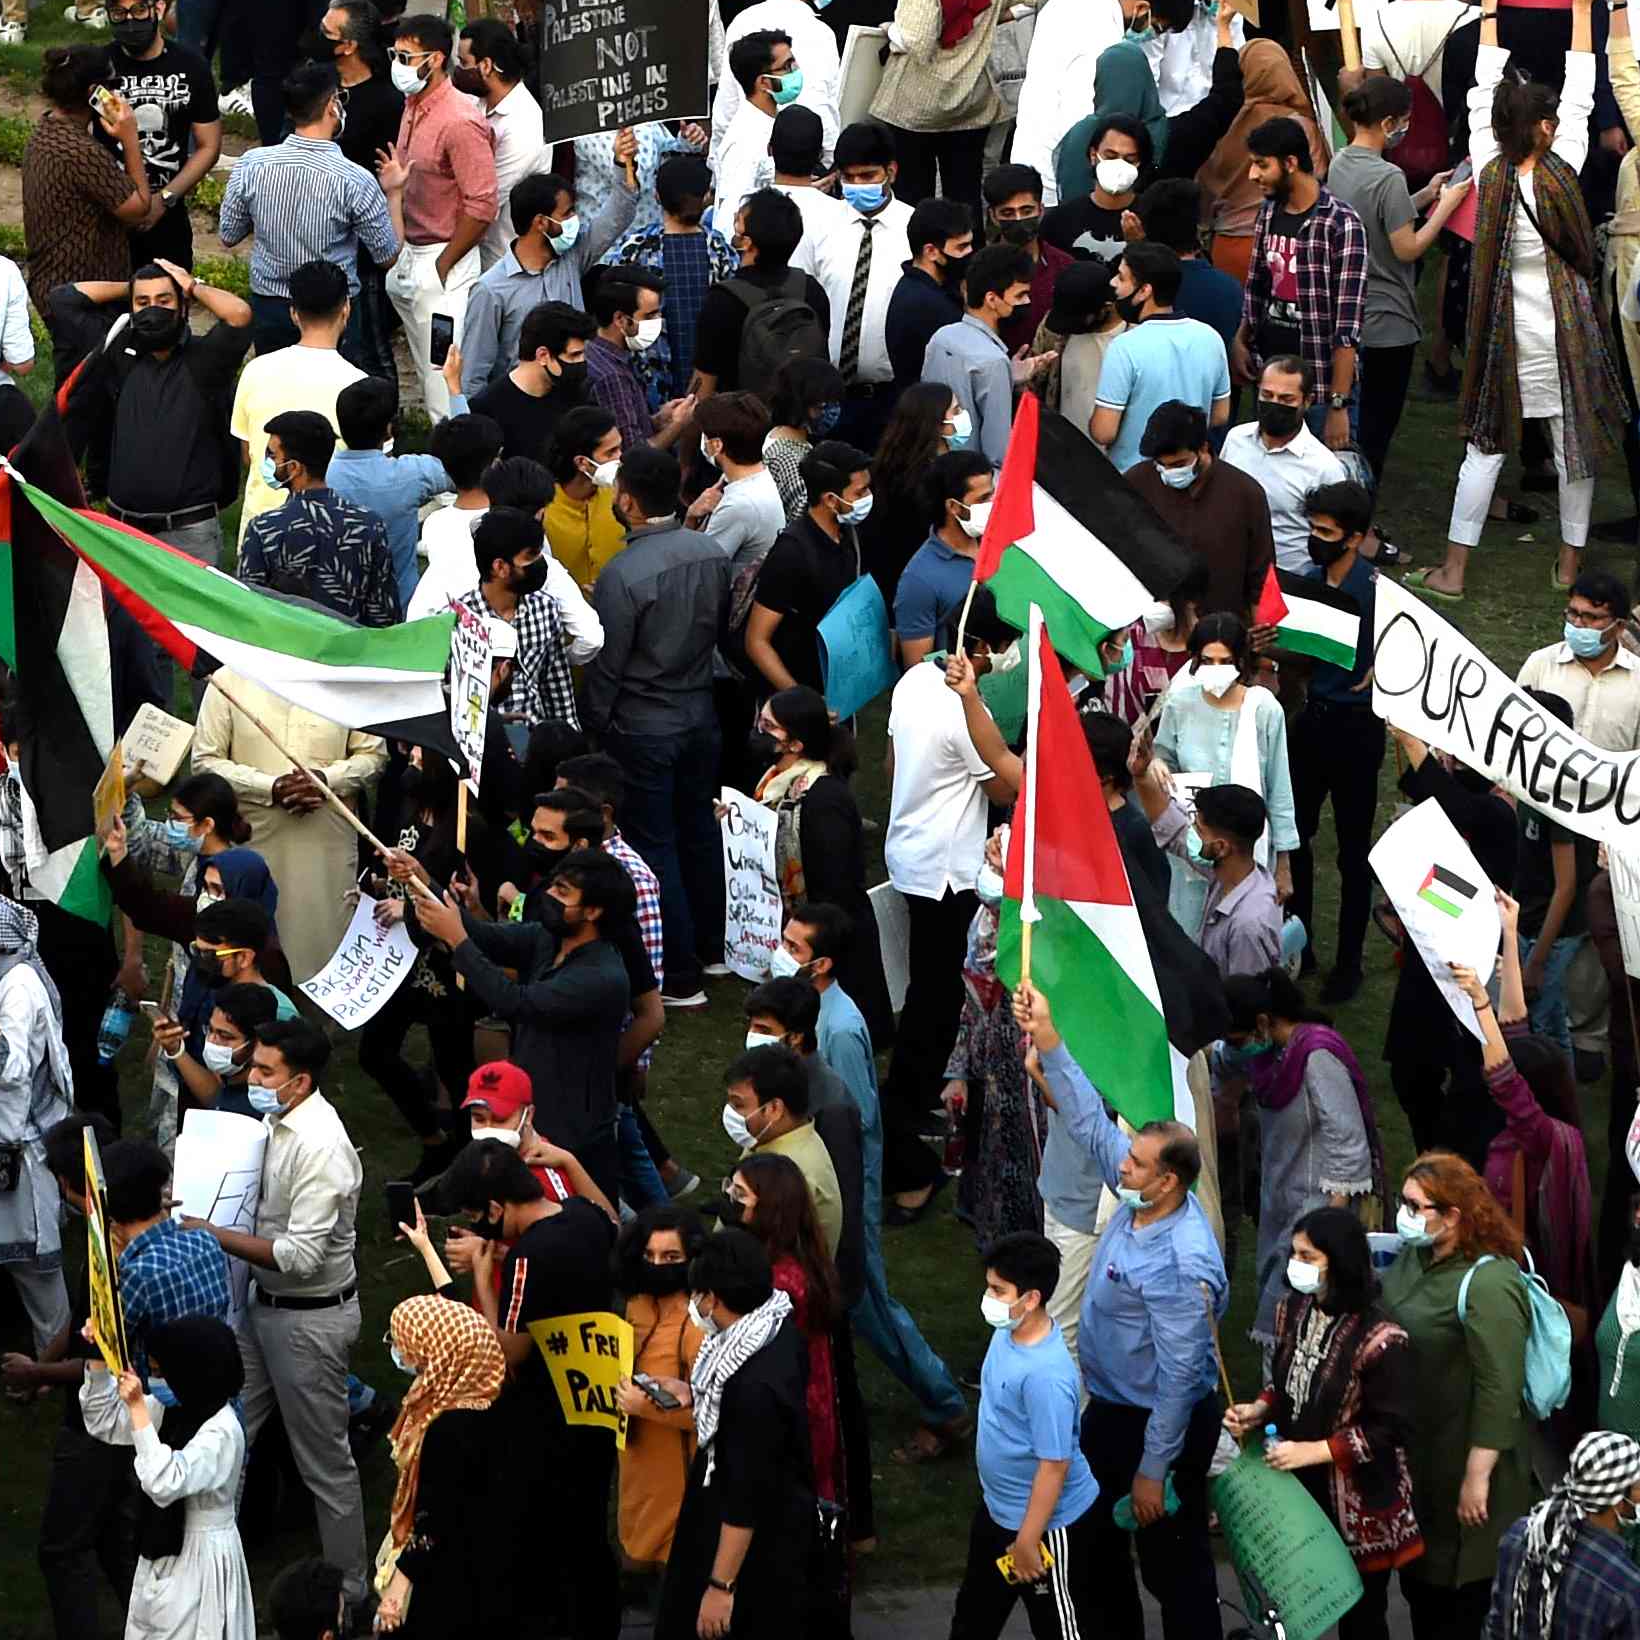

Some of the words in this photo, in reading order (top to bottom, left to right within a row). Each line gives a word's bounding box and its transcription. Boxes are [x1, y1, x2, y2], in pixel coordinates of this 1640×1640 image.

[543, 5, 626, 51] PALESTINE
[595, 23, 658, 70] NOT
[645, 63, 668, 88] IN
[597, 86, 669, 128] PIECES
[1375, 610, 1487, 751] OUR
[303, 932, 371, 1001] Pakistan
[339, 956, 375, 997] stands
[330, 944, 405, 1021] Palestine
